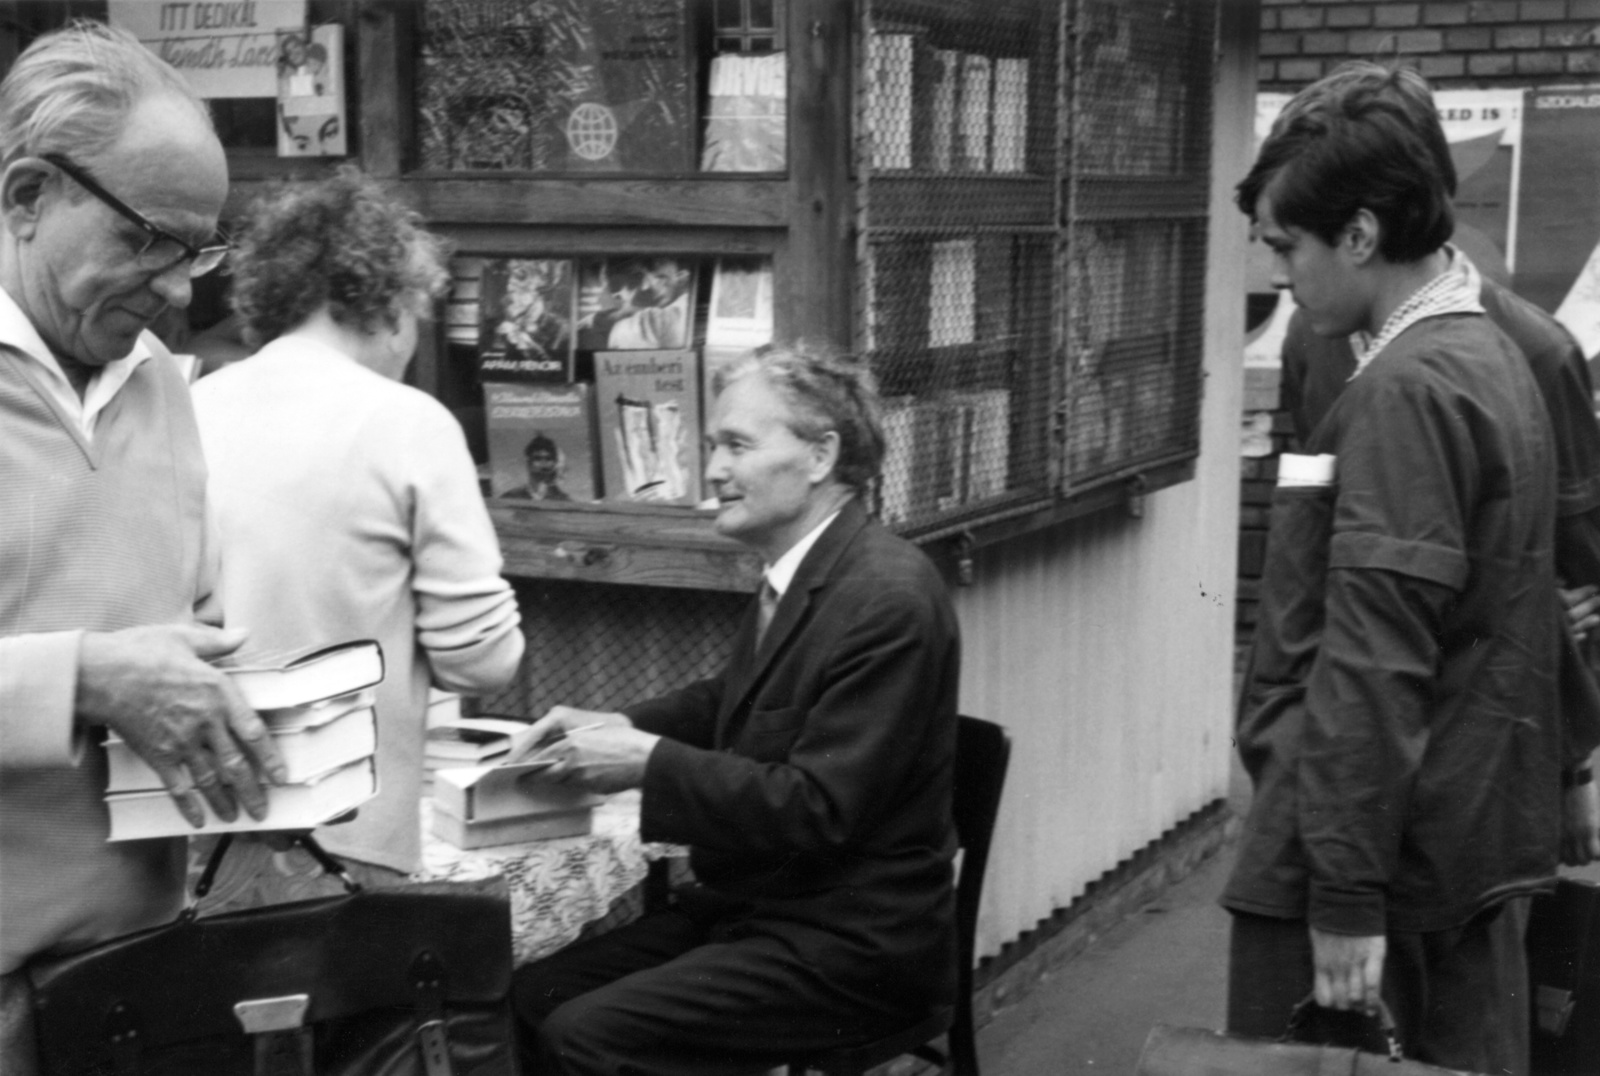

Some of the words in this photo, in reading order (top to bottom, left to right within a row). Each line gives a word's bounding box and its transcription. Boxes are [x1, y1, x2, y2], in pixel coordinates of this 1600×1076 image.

[160, 3, 191, 31] ITT
[1482, 108, 1500, 121] IS
[603, 358, 622, 375] Az
[625, 356, 683, 375] emberi
[655, 378, 684, 393] test
